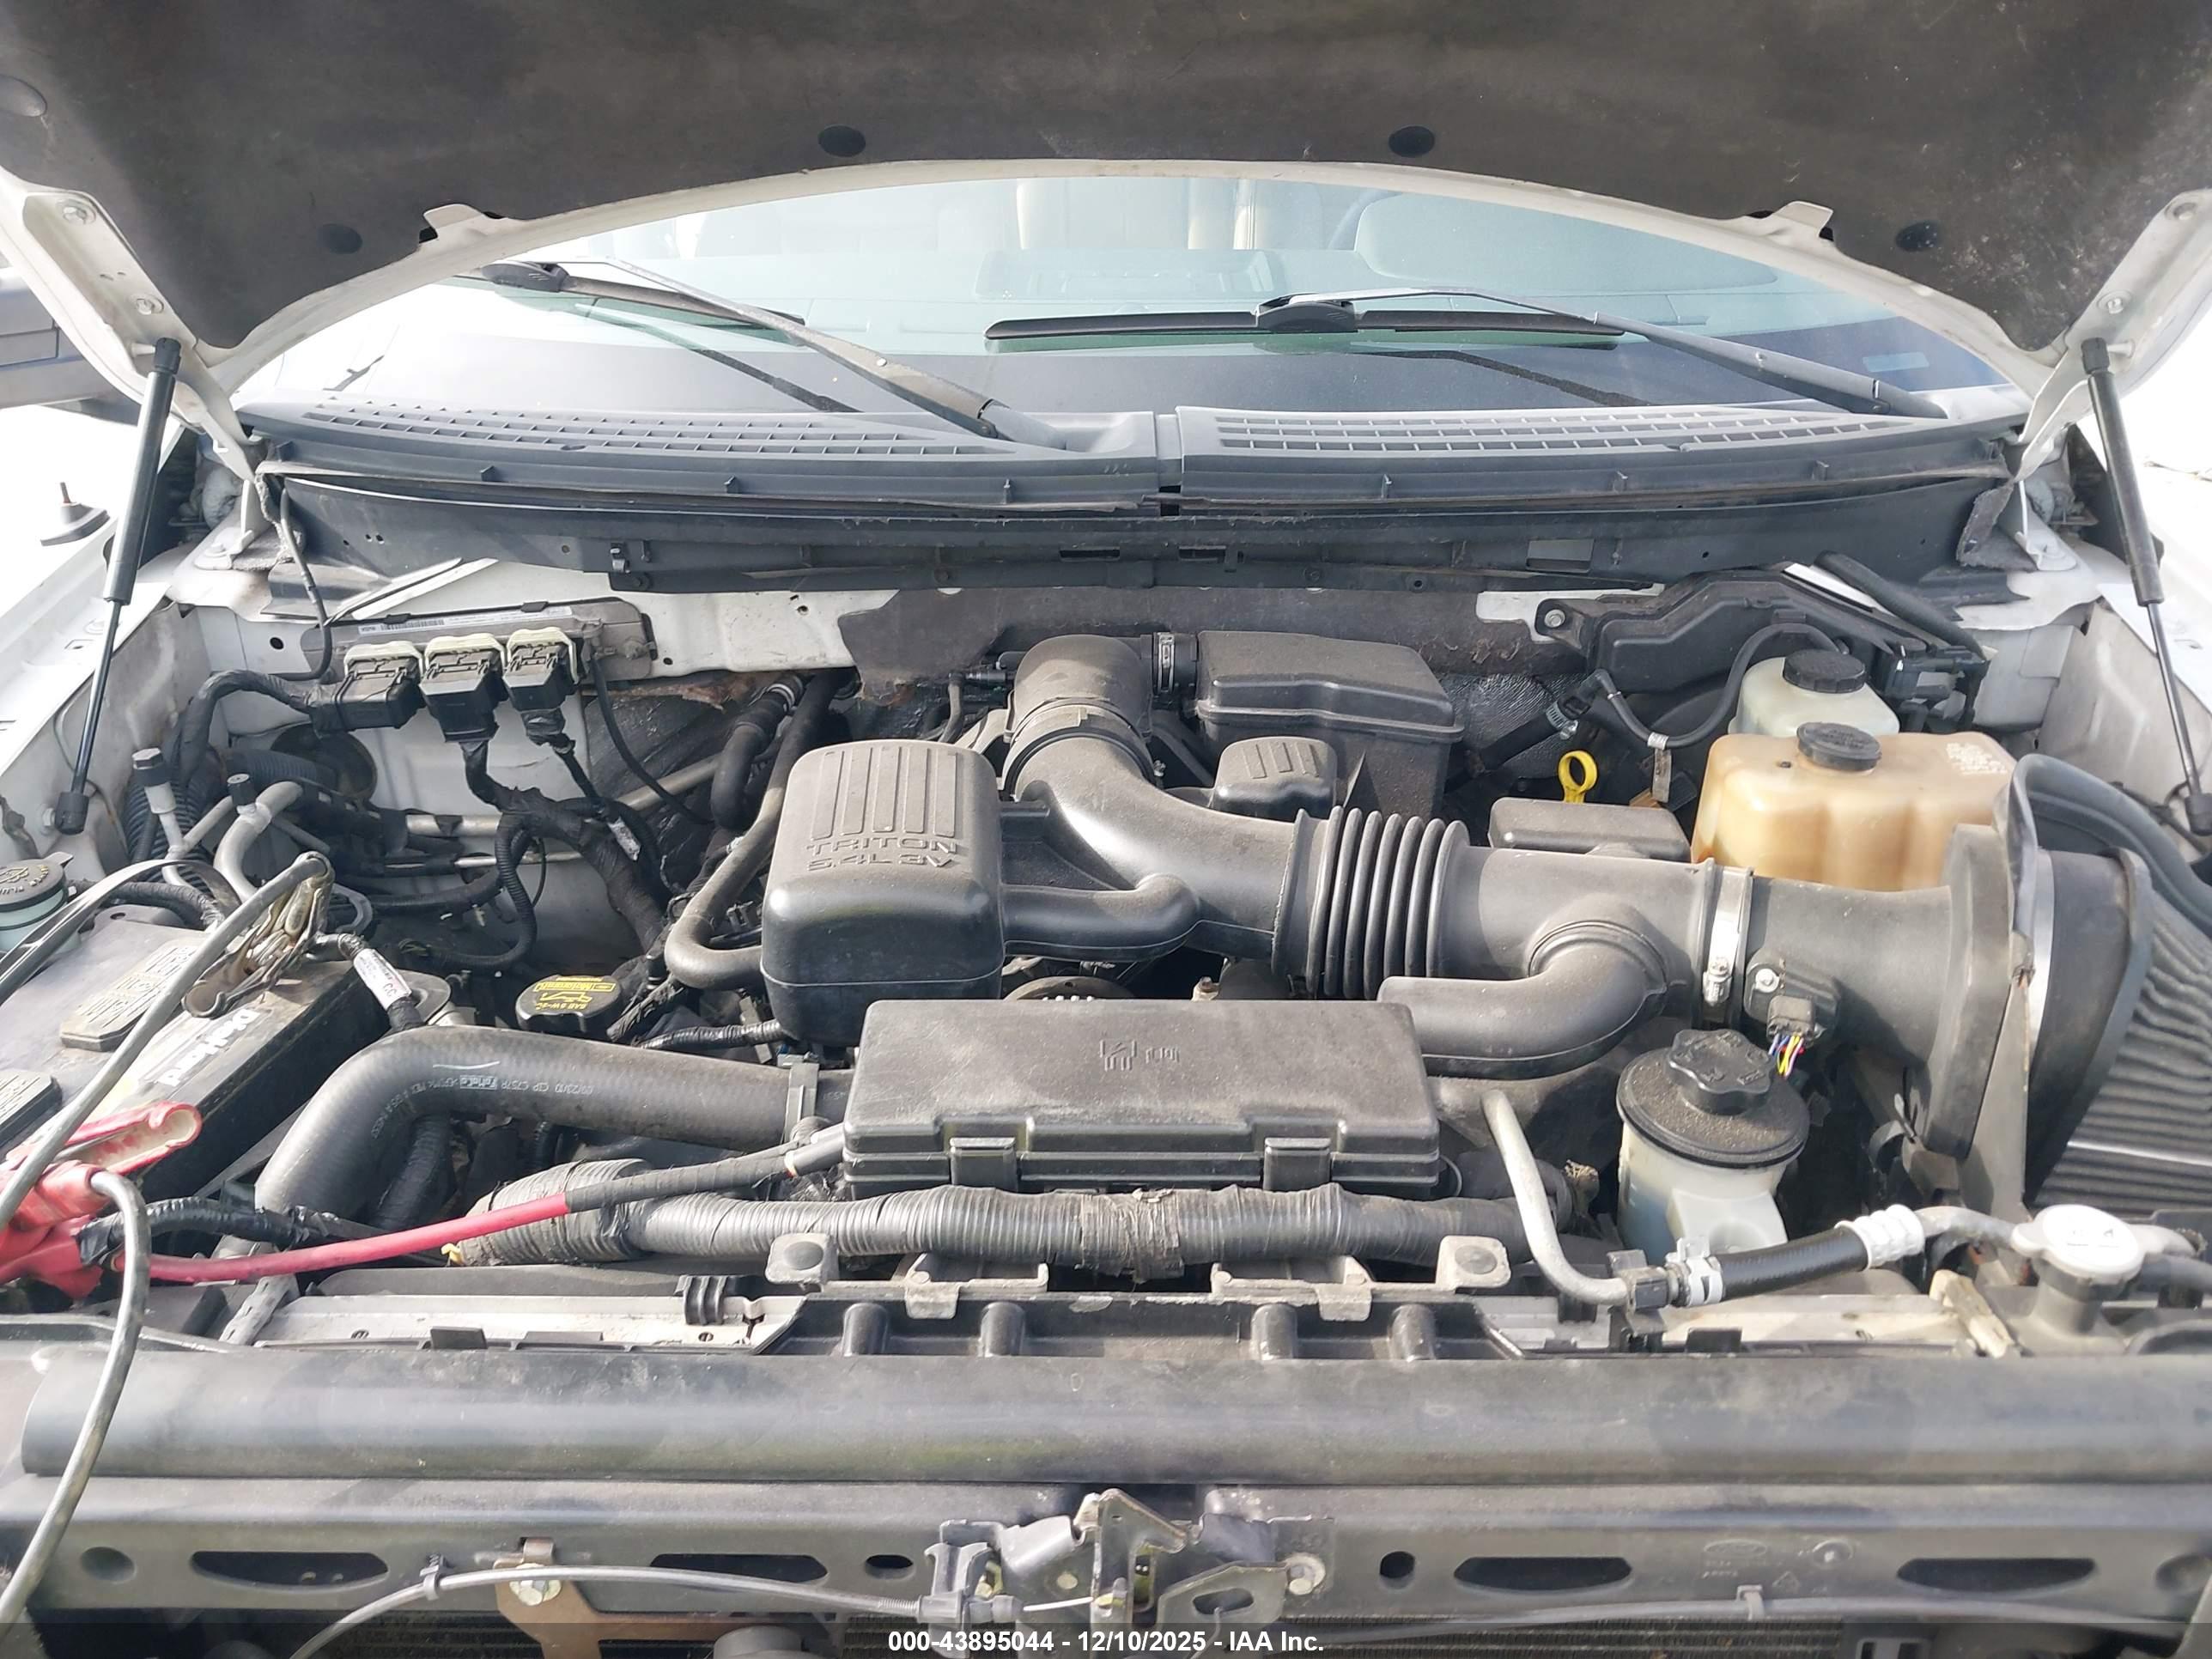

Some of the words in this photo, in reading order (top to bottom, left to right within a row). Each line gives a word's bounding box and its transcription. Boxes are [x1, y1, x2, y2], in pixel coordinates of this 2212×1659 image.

[805, 837, 957, 856] TRITON
[806, 854, 894, 871] 5.4L
[899, 854, 953, 867] 3V
[159, 1008, 259, 1088] DieHard
